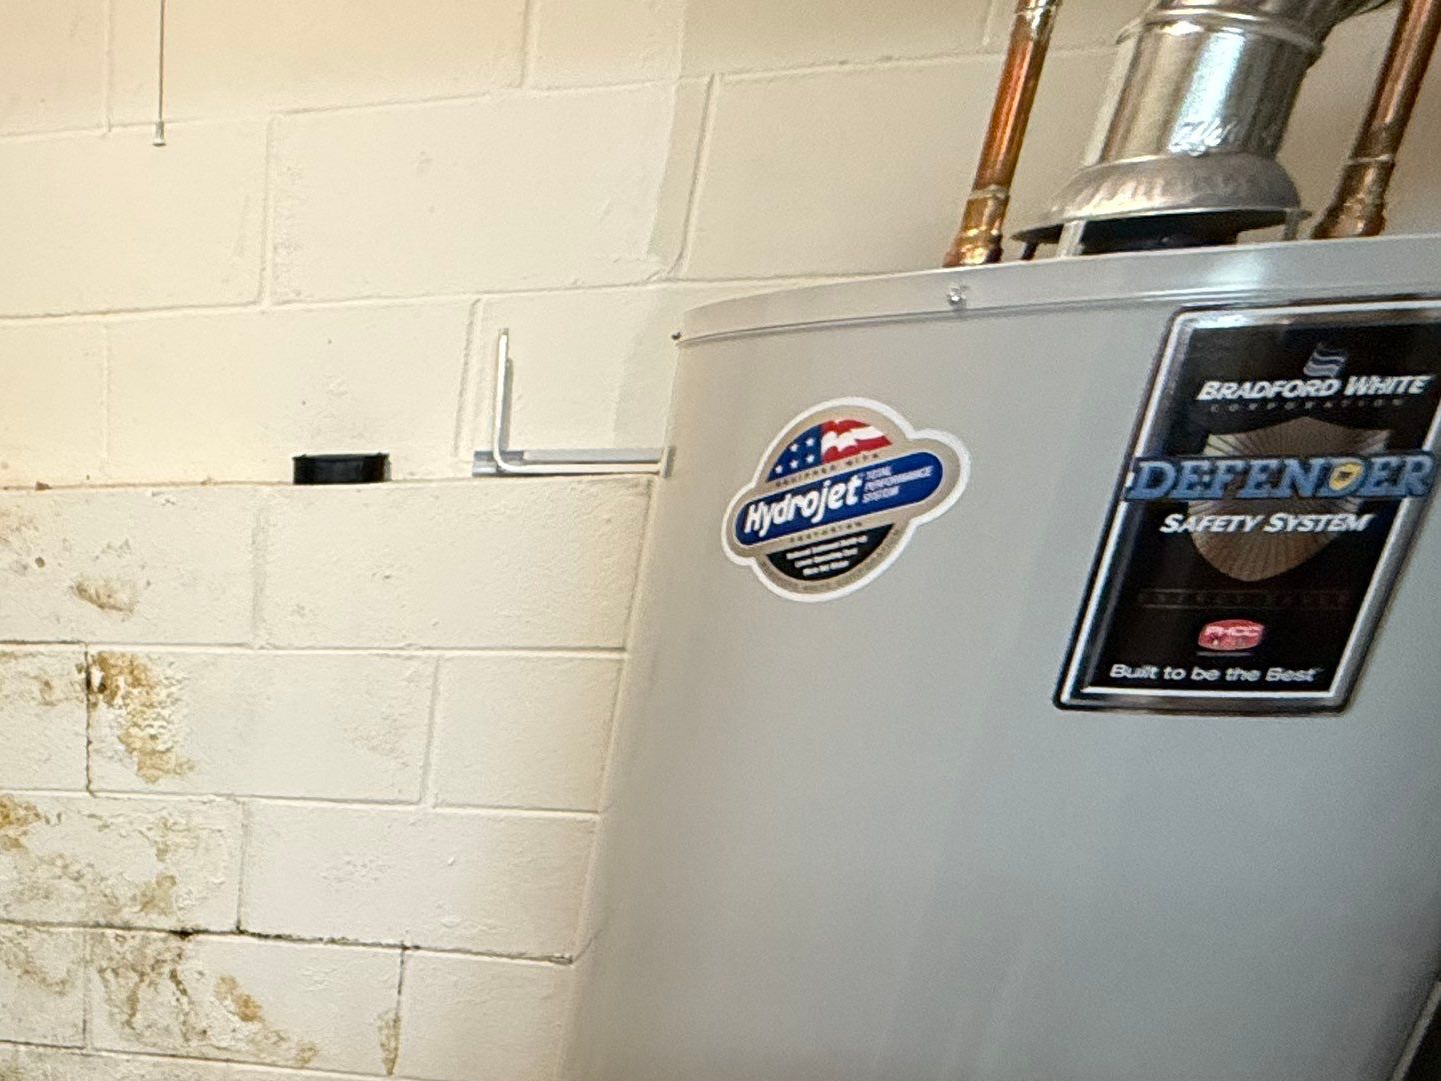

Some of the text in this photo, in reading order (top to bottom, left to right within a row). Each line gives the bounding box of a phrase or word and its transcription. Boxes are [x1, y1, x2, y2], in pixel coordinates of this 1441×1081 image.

[1196, 375, 1434, 401] BRADFORD WHITE
[1126, 453, 1434, 499] DEFENDER
[744, 475, 863, 538] Hydrojet
[1160, 512, 1376, 533] SAFETY SYSTEM
[1109, 663, 1318, 682] Built to be the Best
